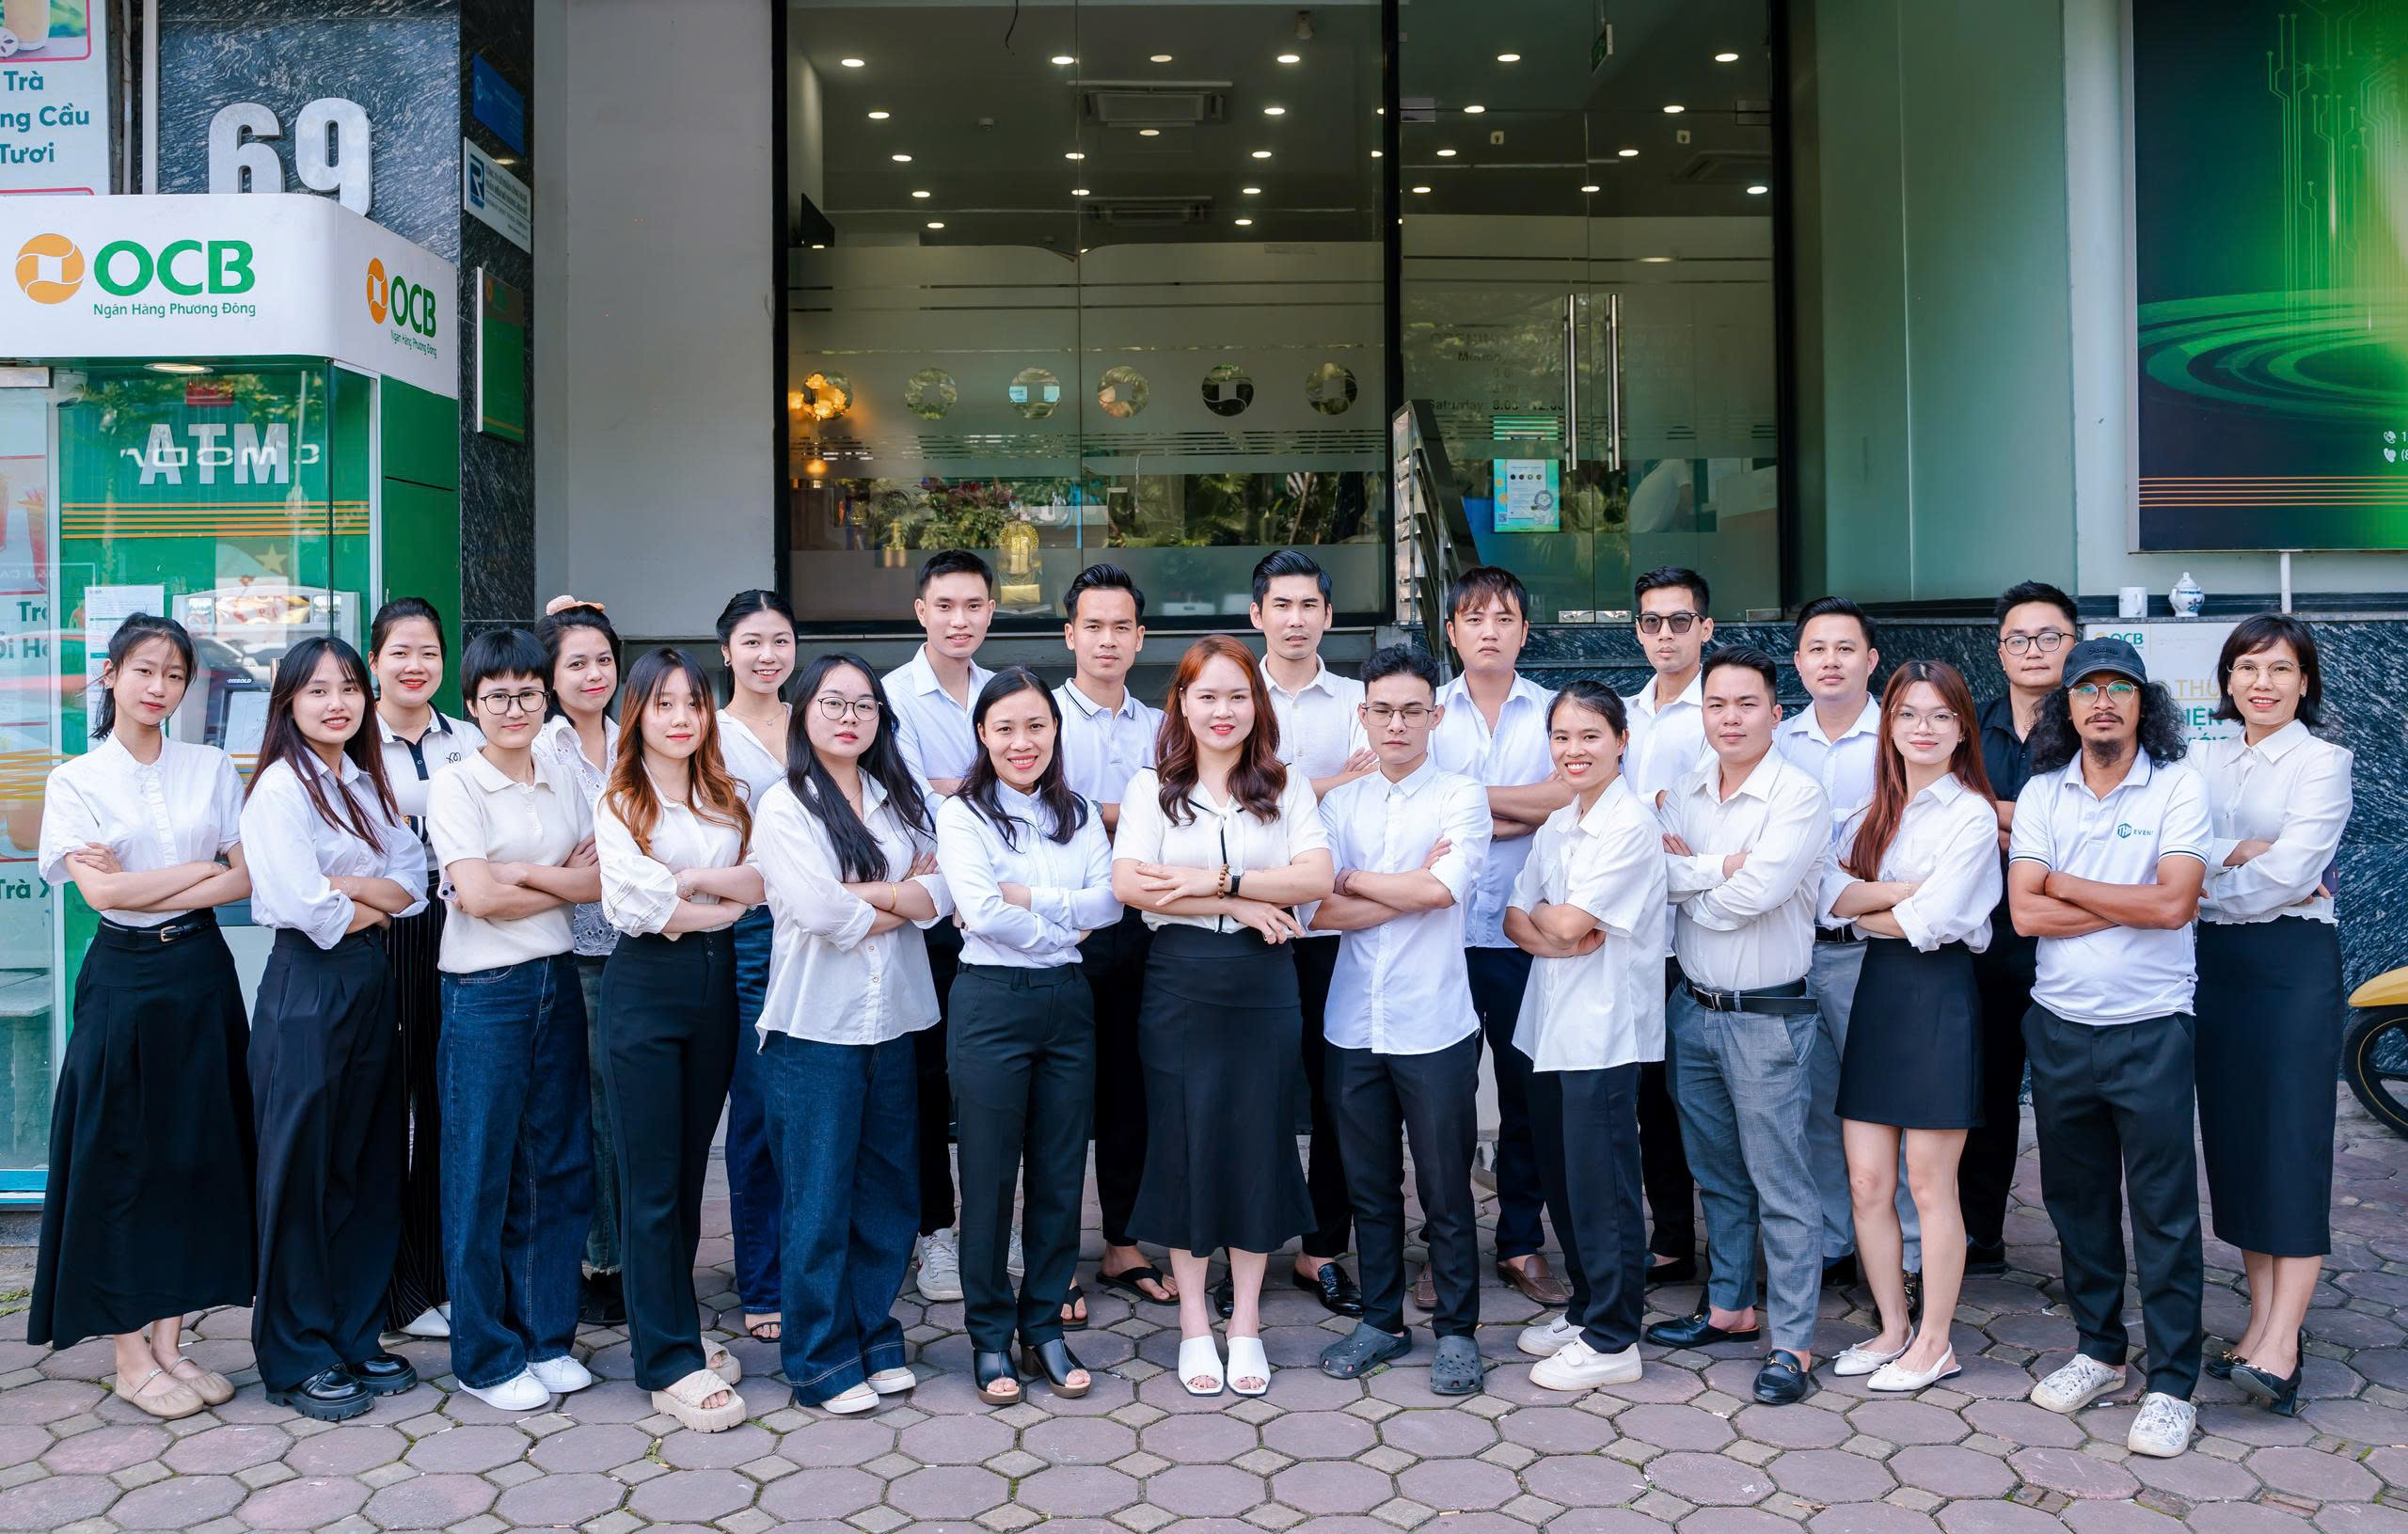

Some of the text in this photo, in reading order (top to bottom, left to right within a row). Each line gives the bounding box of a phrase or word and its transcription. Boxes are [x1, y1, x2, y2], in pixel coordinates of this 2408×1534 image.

[4, 71, 44, 91] Trà
[39, 103, 89, 126] Cầu
[0, 141, 55, 164] Tươi
[208, 98, 374, 216] 69
[94, 240, 256, 296] OCB
[93, 302, 256, 318] Ngân Hàng Phương Đông
[390, 276, 436, 338] OCB
[138, 423, 290, 484] ATM
